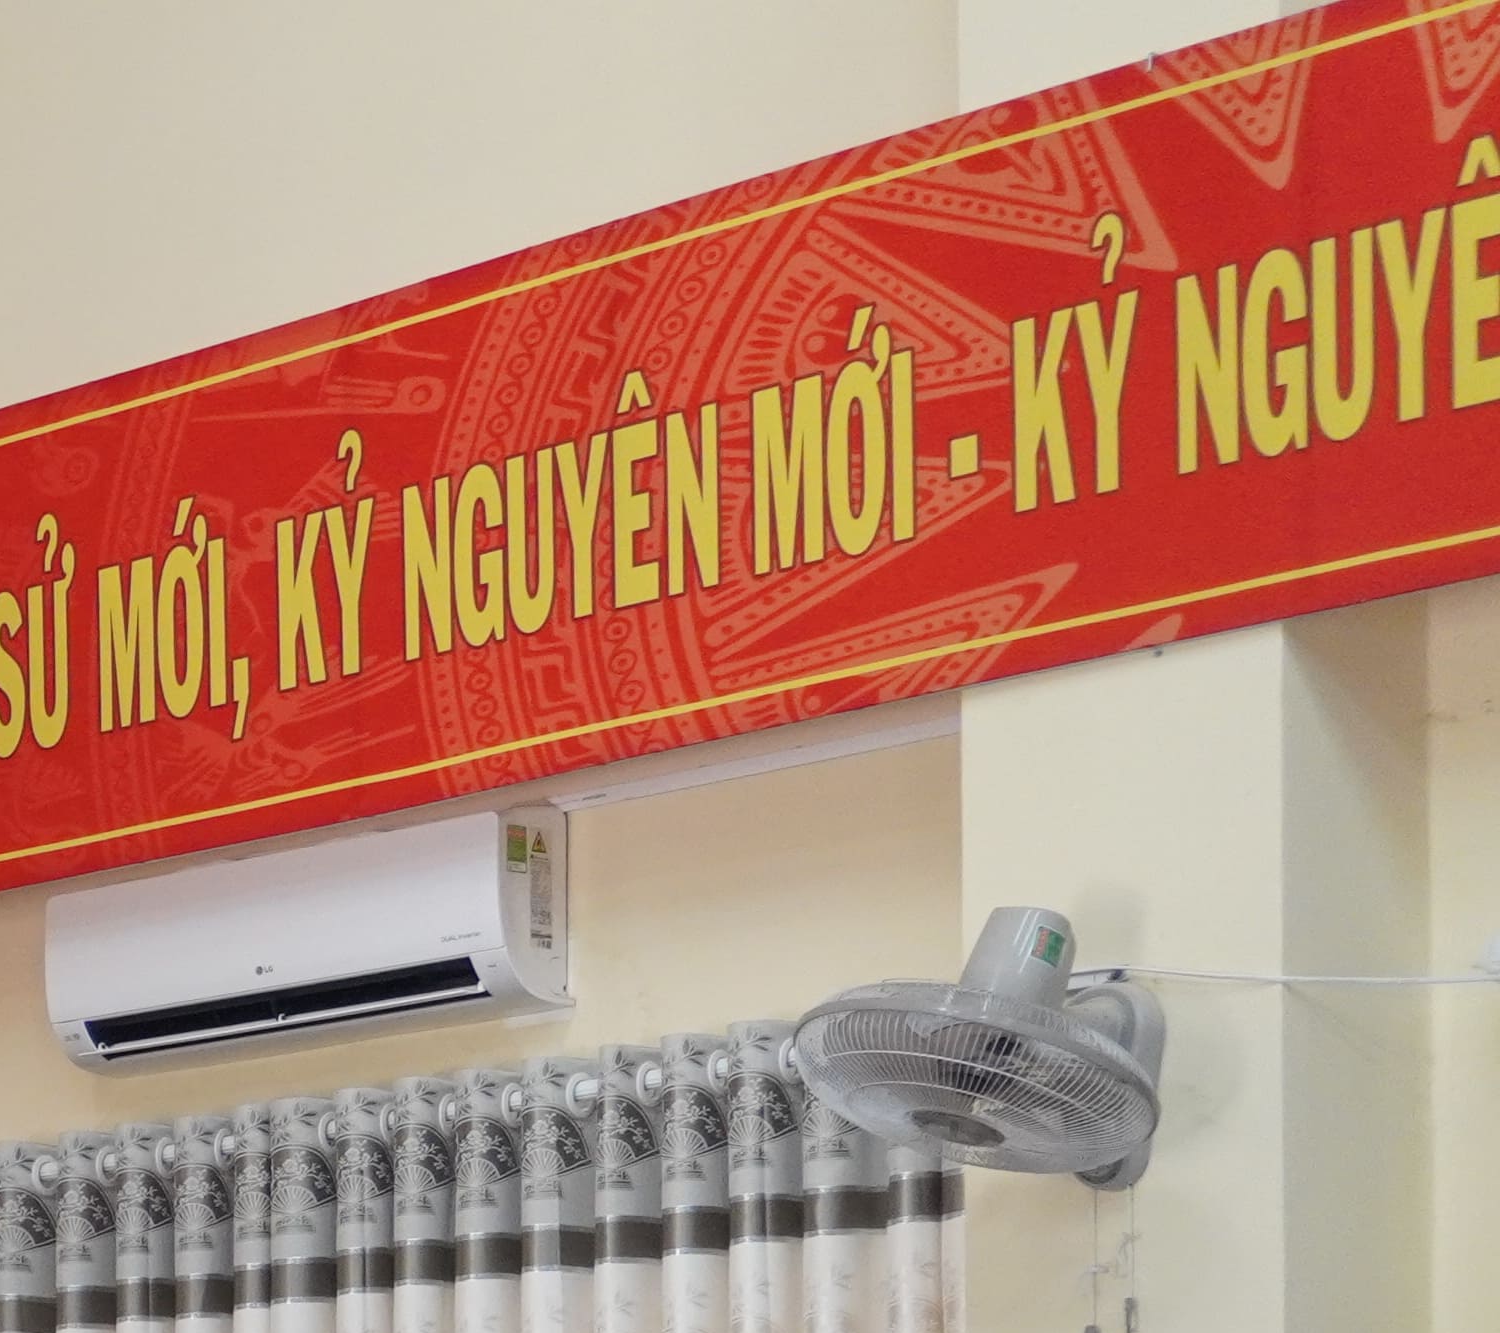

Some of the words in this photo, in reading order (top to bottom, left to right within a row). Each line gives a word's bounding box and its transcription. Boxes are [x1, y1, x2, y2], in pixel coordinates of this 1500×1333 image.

[98, 497, 250, 740] MỚI,
[276, 429, 374, 690] KỶ
[403, 371, 719, 661] NGUYÊN
[752, 306, 914, 575] MỚI
[1013, 213, 1138, 513] KỶ
